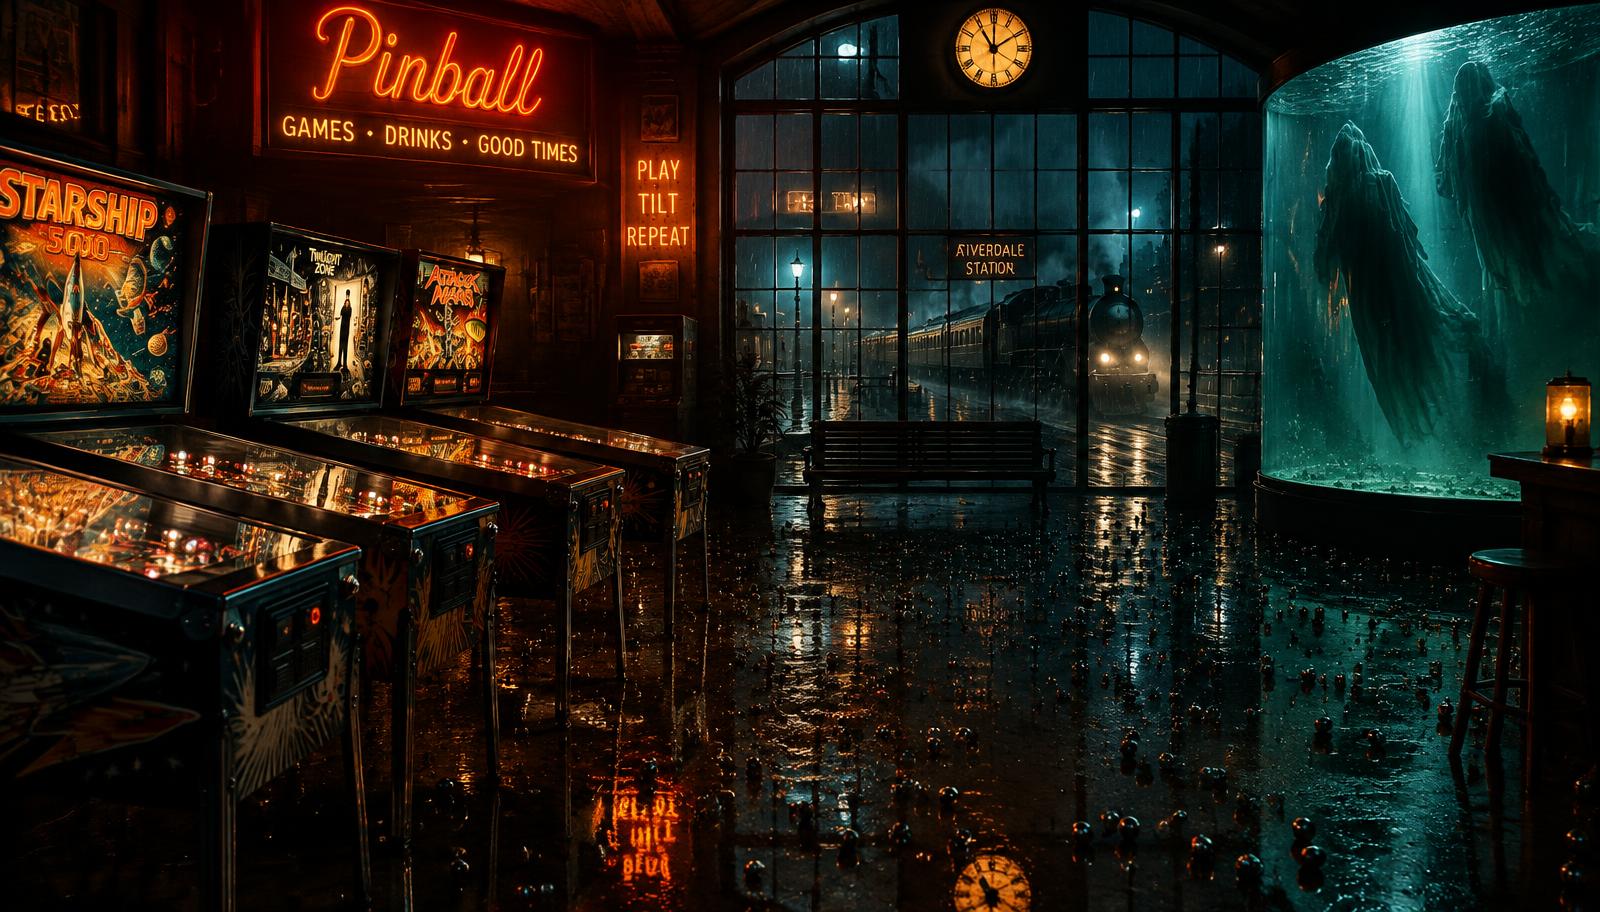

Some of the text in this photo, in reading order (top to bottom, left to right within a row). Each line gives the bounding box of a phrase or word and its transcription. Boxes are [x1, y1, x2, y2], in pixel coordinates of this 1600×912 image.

[313, 6, 543, 115] Pinball
[282, 115, 578, 163] GAMES DRINKS GOOD TIMES
[637, 159, 680, 180] PLAY
[0, 168, 158, 242] STARSHIP
[637, 192, 679, 214] TILT
[627, 226, 690, 247] REPEAT
